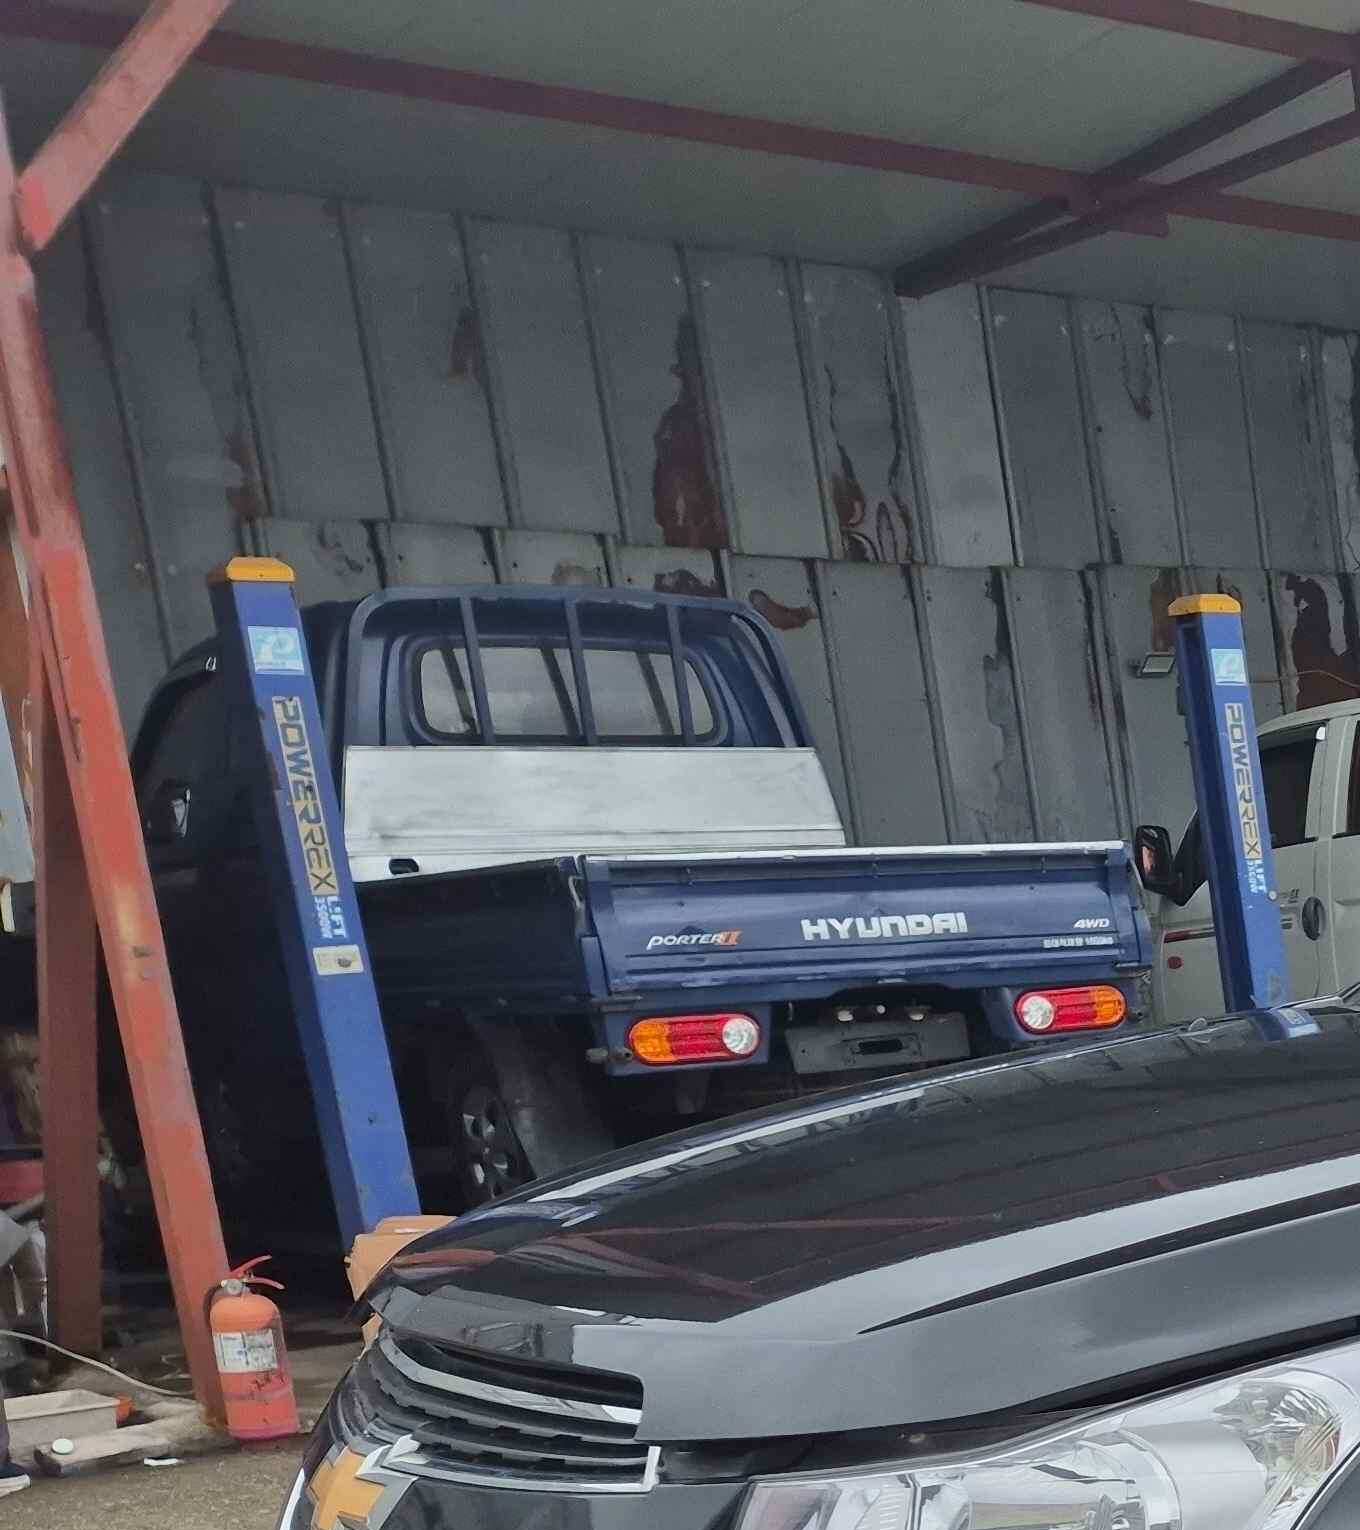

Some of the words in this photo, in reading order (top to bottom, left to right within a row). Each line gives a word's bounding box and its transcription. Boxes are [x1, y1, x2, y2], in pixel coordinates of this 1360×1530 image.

[275, 697, 337, 891] POWERREX
[1227, 705, 1260, 855] POWERREX
[327, 896, 346, 937] LIFT
[801, 912, 967, 940] HYUNDAI
[1073, 918, 1110, 928] 4WD
